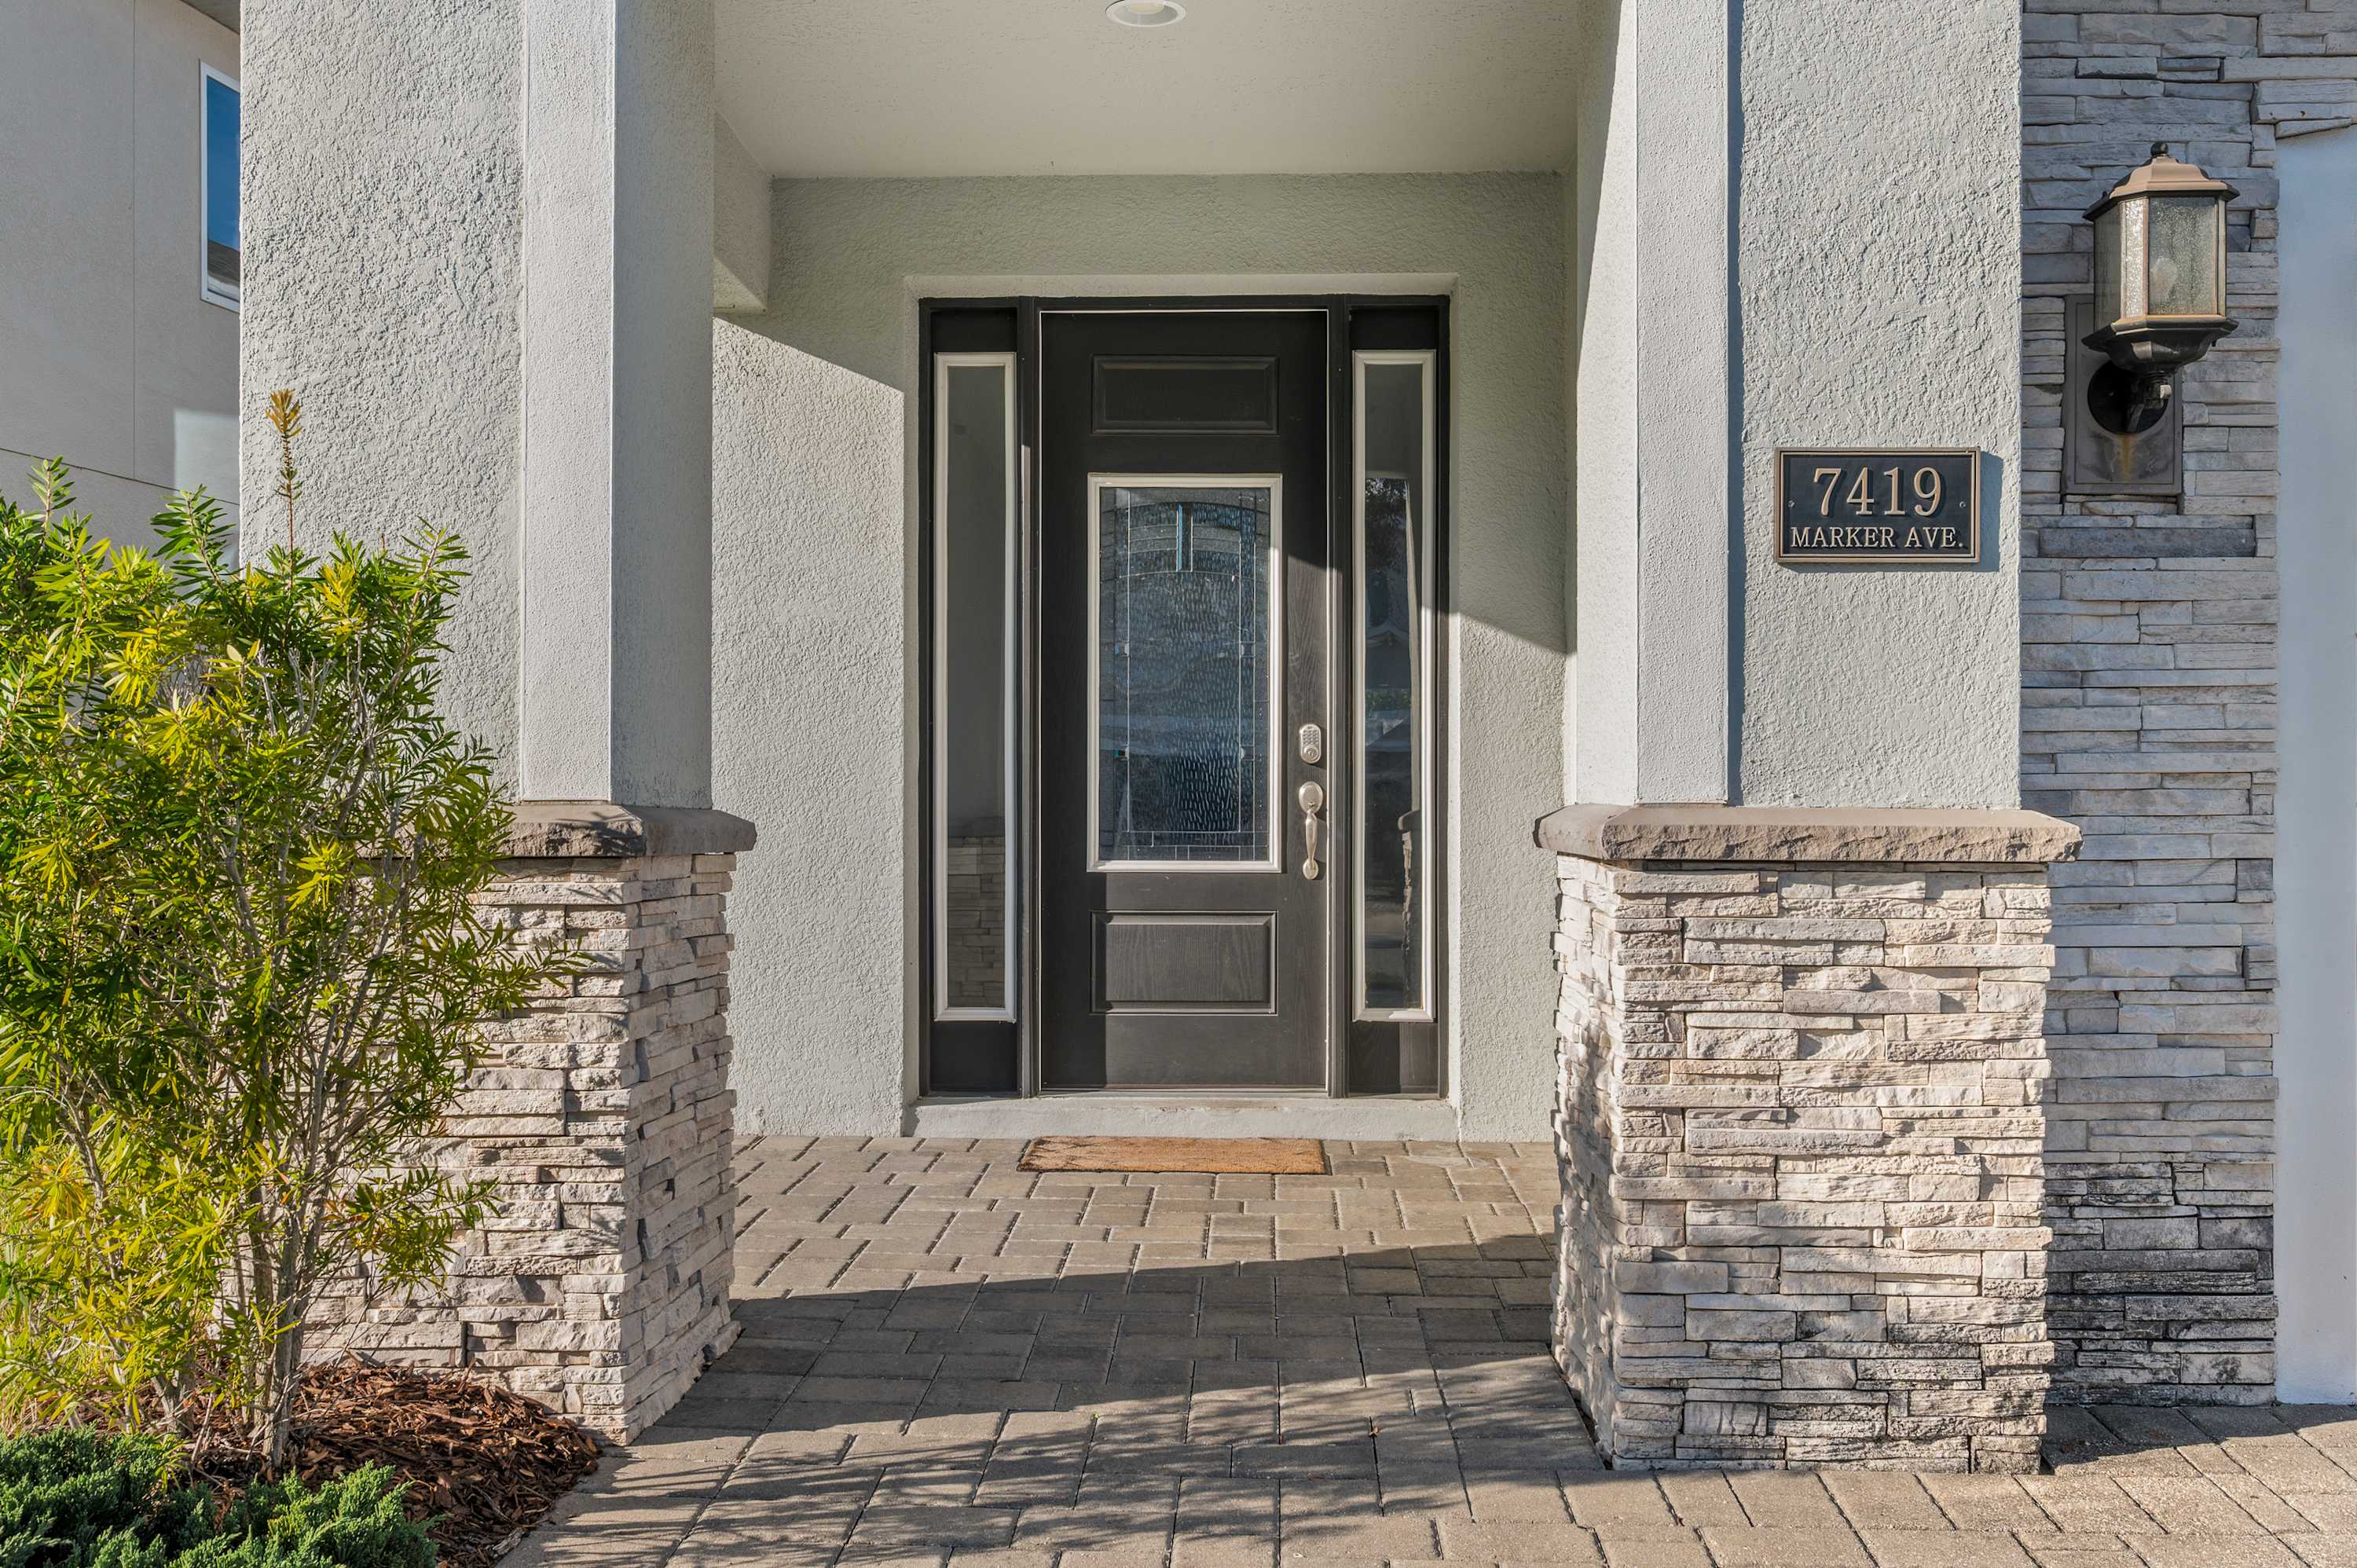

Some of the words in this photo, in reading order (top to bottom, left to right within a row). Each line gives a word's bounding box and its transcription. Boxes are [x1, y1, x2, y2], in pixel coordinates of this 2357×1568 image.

[1813, 467, 1942, 517] 7419
[1791, 526, 1895, 548] MARKER
[1904, 526, 1963, 548] AVE.
